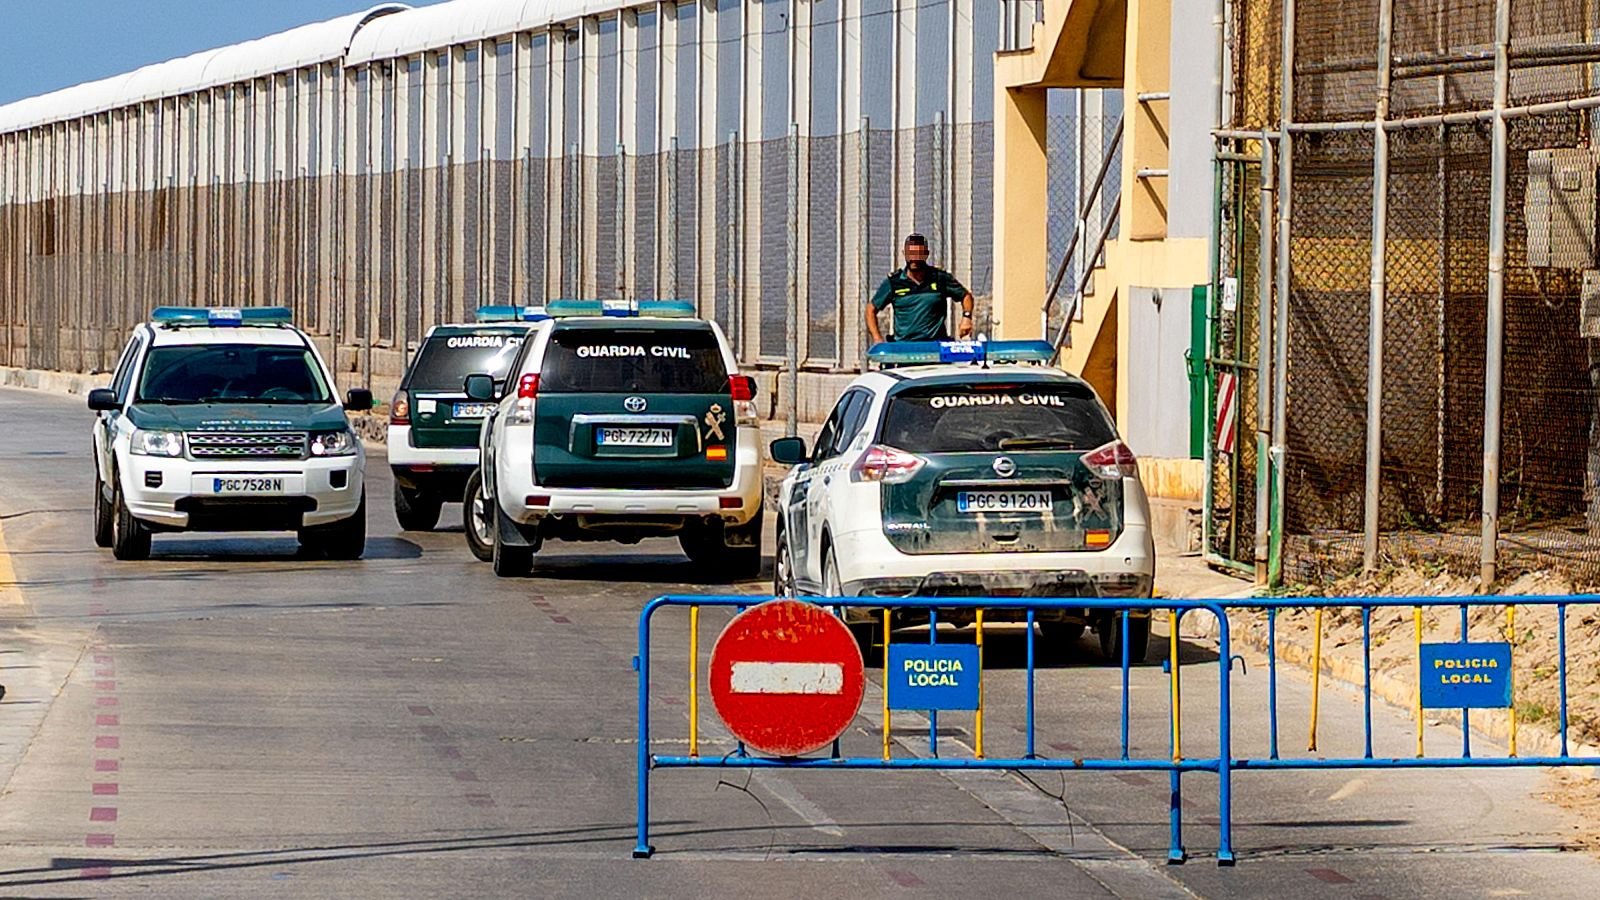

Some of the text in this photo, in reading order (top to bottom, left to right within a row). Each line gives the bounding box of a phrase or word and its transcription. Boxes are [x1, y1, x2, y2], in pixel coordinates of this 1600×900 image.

[447, 336, 502, 348] GUARDIA
[577, 345, 691, 359] GUARDIA CIVIL
[930, 393, 1065, 409] GUARDIA CIVIL
[967, 493, 1050, 509] PGC 9120 N
[904, 658, 963, 673] POLICIA
[1433, 658, 1498, 669] POLICIA
[908, 673, 958, 687] LOCAL
[1441, 674, 1492, 684] LOCAL
